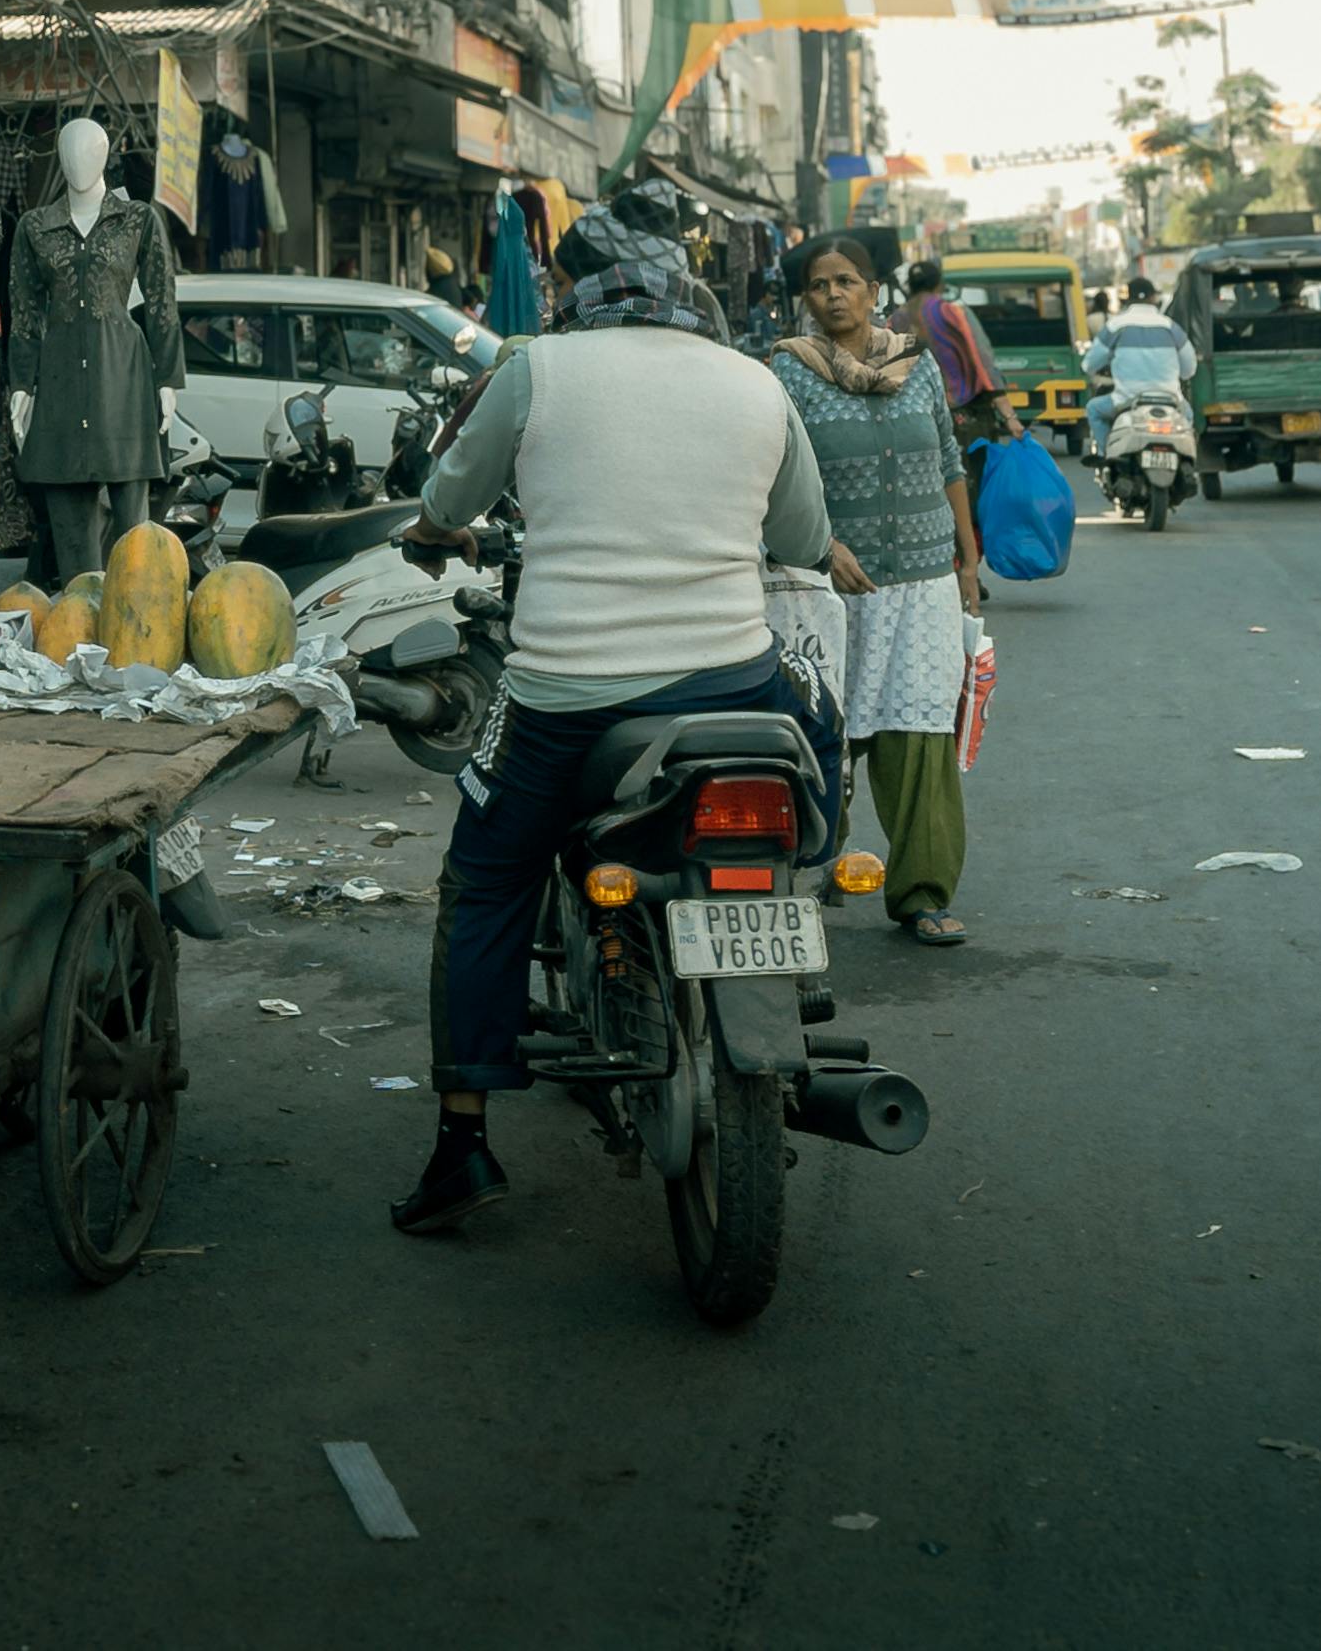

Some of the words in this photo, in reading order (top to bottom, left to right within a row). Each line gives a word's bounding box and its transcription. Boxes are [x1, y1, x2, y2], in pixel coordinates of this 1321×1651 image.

[369, 588, 442, 611] Activa
[706, 901, 801, 934] PB07B
[679, 933, 697, 945] IND
[711, 936, 808, 969] V6606
